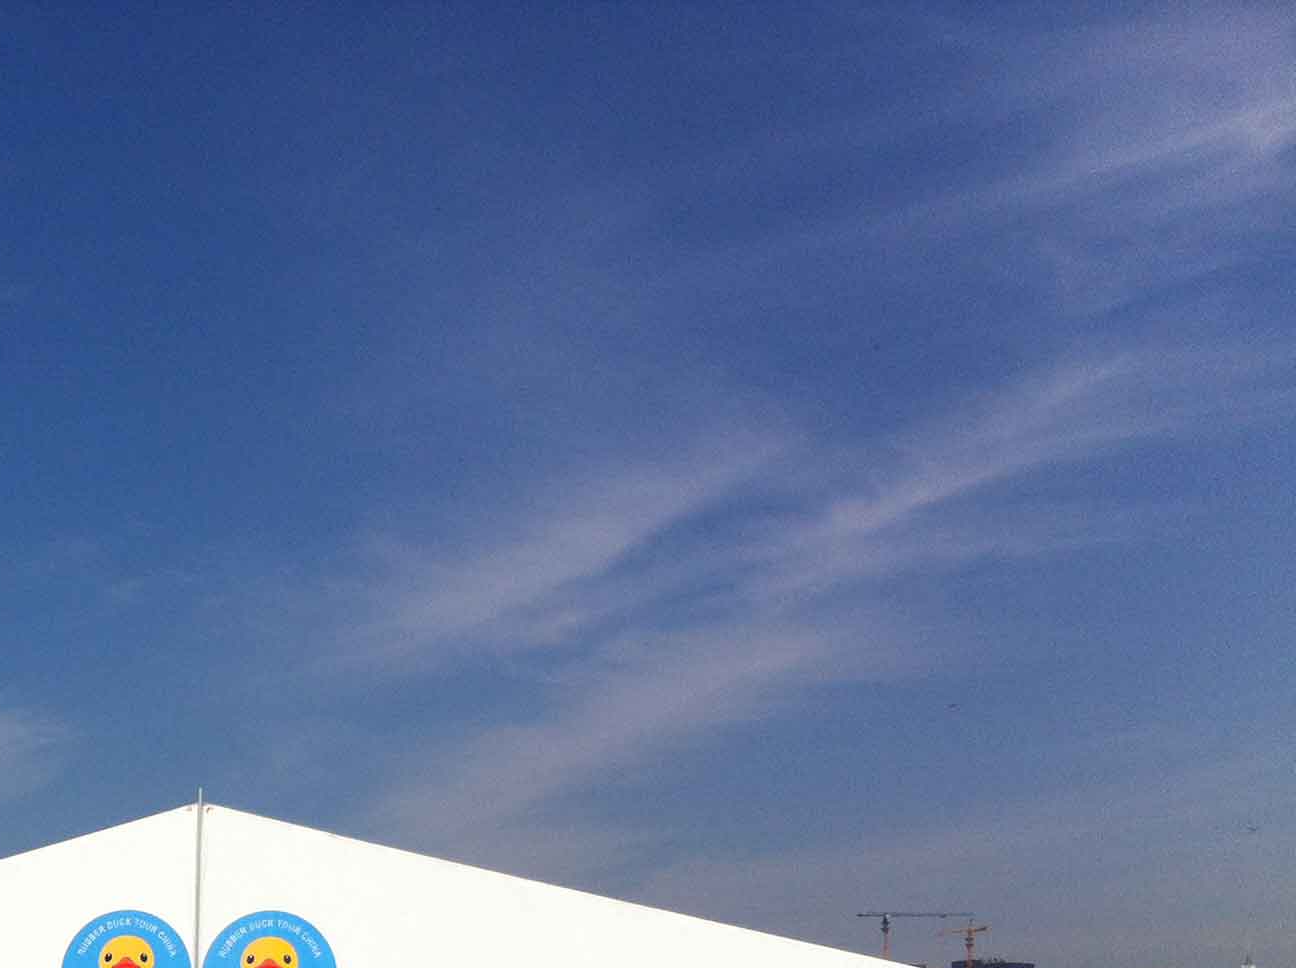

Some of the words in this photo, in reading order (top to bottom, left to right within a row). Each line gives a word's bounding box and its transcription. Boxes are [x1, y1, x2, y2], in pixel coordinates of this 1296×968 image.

[107, 918, 133, 930] DUCK
[135, 918, 158, 935] TOUR
[158, 930, 177, 957] CHINA
[249, 919, 274, 931] DUCK
[277, 919, 302, 935] TOUR
[301, 932, 322, 959] CHINA
